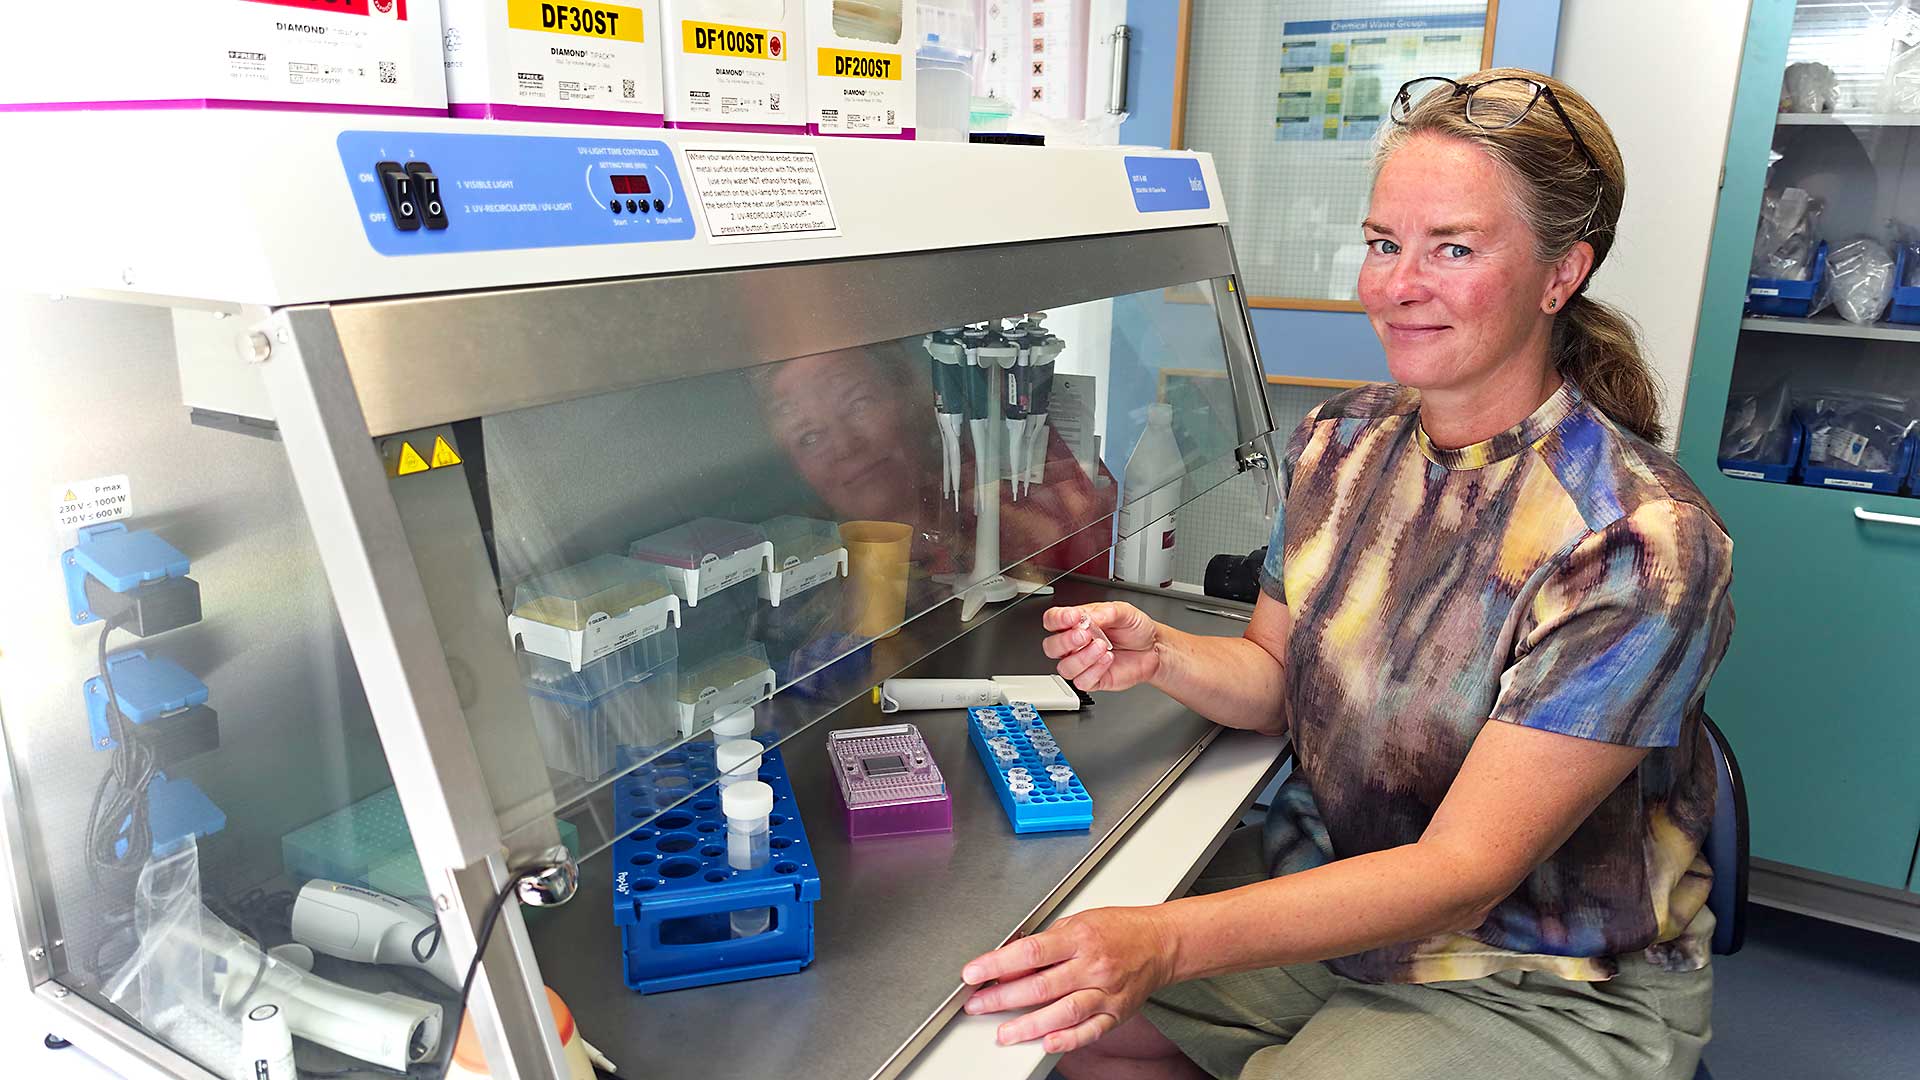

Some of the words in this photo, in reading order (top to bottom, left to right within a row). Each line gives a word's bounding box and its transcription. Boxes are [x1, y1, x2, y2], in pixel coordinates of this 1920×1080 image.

[542, 3, 619, 35] DF30ST
[1331, 22, 1367, 31] Chemical
[1369, 21, 1395, 29] Waste
[695, 27, 764, 54] DF100ST
[835, 55, 890, 78] DF200ST
[578, 147, 606, 155] UV-LIGHT
[623, 148, 659, 156] CONTROLLER
[358, 173, 374, 183] ON
[464, 181, 491, 189] VISIBLE
[493, 181, 513, 189] LIGHT
[370, 214, 387, 222] OFF
[103, 483, 121, 493] max
[59, 504, 76, 514] 230
[78, 502, 84, 510] V
[95, 496, 116, 507] 1000
[118, 494, 126, 503] W
[61, 515, 78, 525] 120
[96, 509, 112, 518] 600
[113, 507, 122, 515] W
